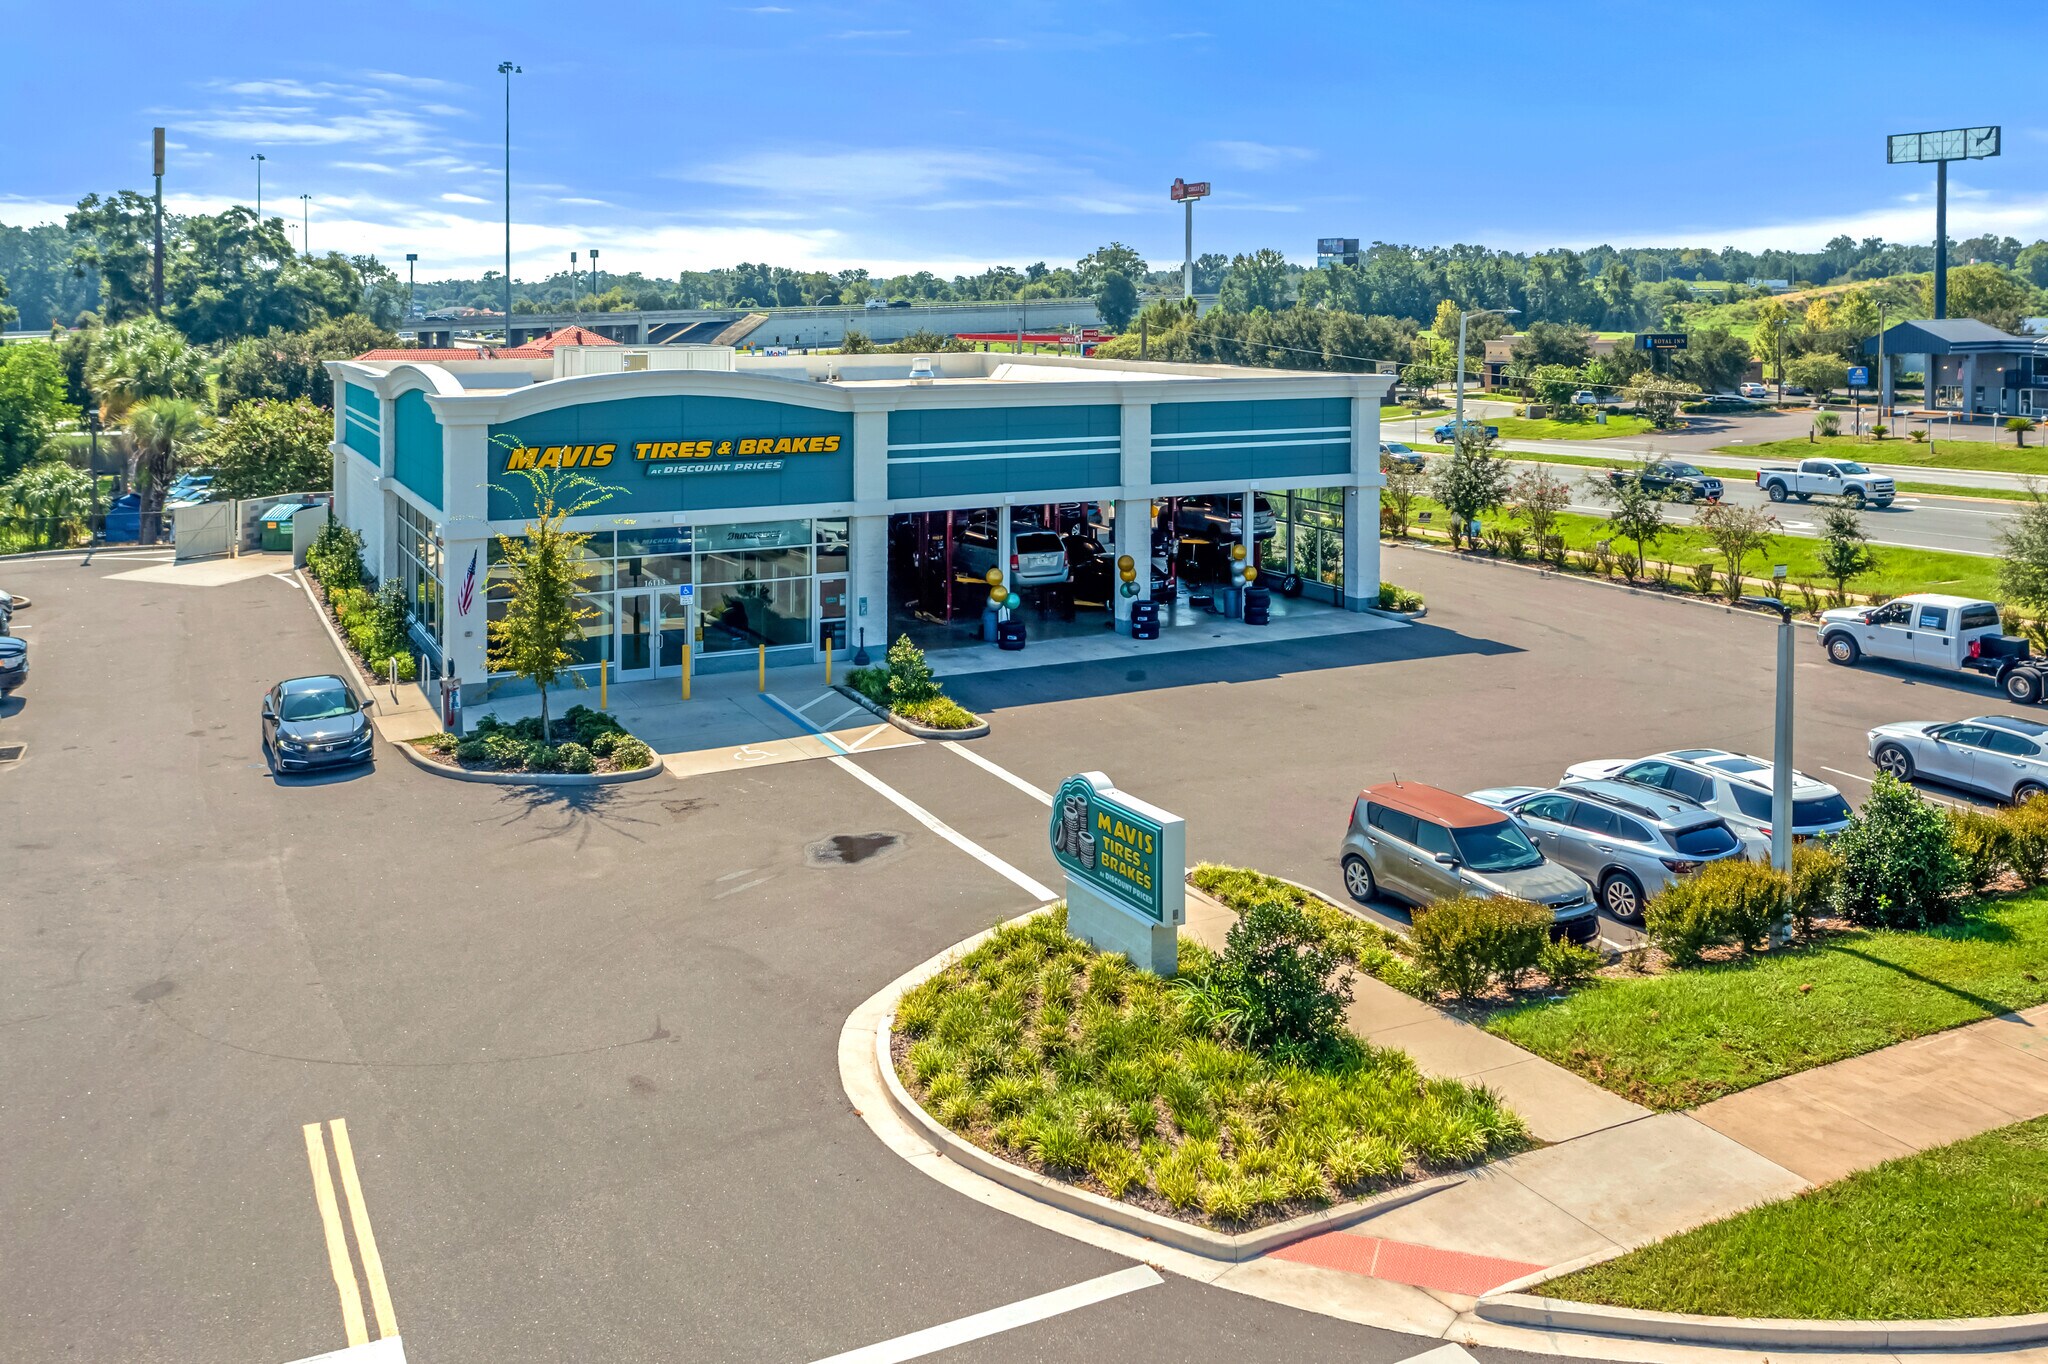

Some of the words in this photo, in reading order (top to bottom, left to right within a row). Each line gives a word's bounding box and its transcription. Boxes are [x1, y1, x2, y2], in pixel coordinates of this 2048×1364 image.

[506, 443, 617, 471] MAVIS
[635, 440, 713, 461] TIRES
[716, 440, 732, 456] &
[737, 434, 842, 456] BRAKES
[663, 463, 731, 474] DISCOUNT
[734, 461, 782, 471] PRICES
[1098, 812, 1153, 854] MAVIS
[1102, 835, 1141, 868] TIRES
[1143, 861, 1150, 872] &
[1101, 851, 1152, 890] BRAKES
[1105, 872, 1133, 893] DISCOUNT
[1132, 887, 1153, 905] PRICES
